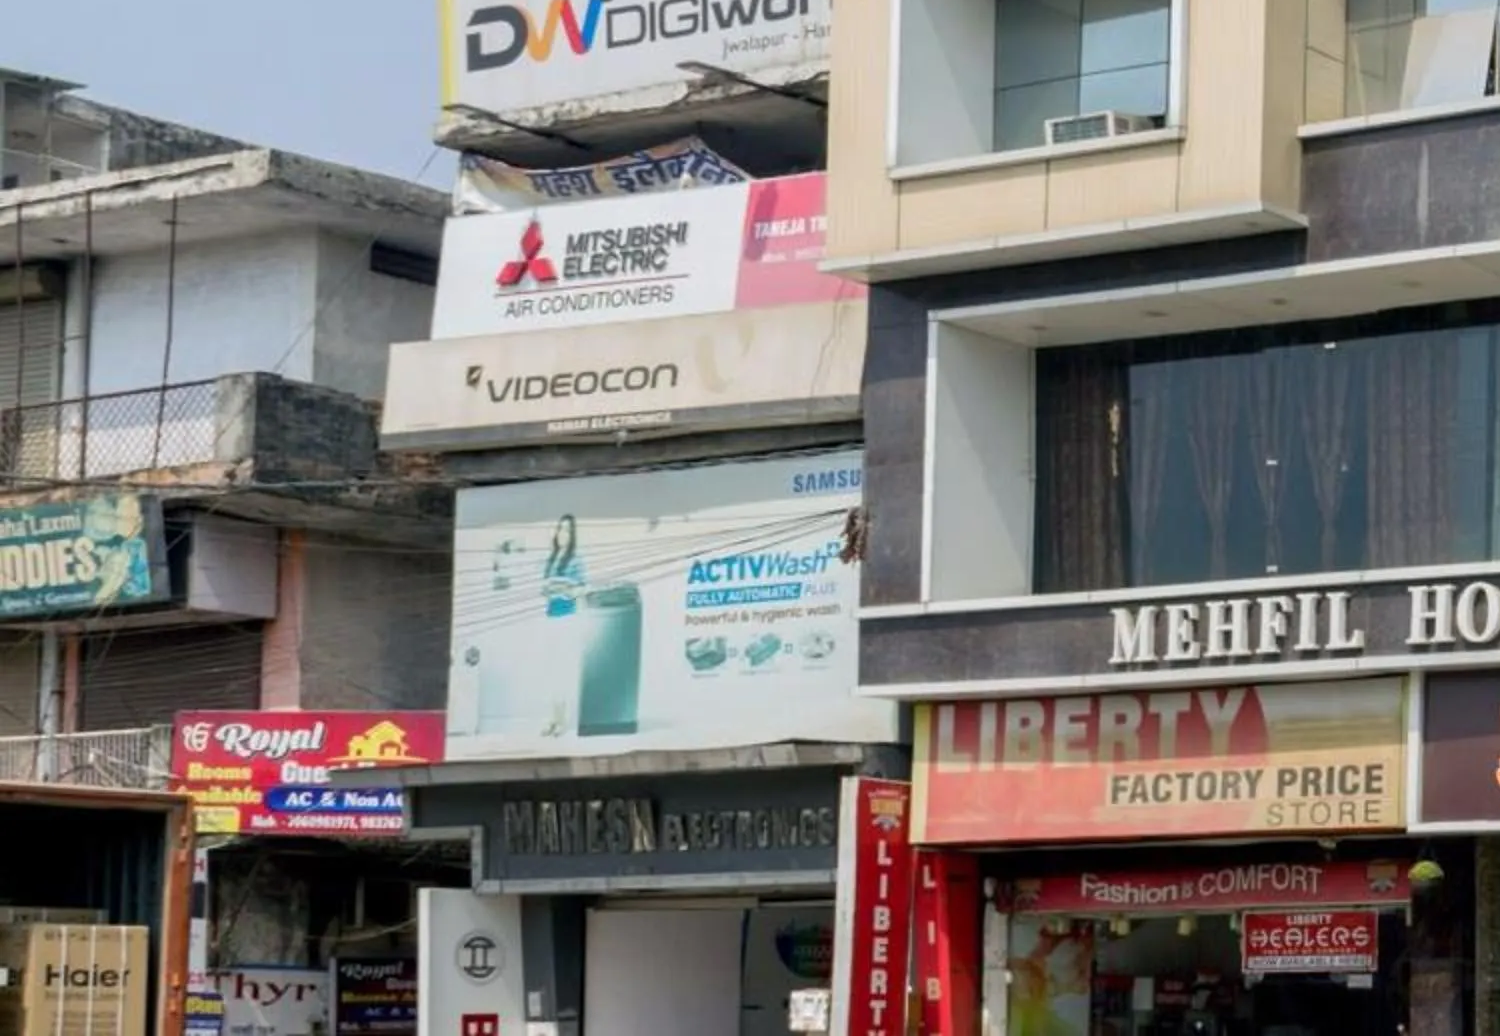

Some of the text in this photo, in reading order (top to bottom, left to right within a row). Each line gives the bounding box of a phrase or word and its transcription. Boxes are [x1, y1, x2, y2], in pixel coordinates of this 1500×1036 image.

[566, 221, 689, 255] MITSUBISHI
[563, 247, 670, 279] ELECTRIC
[504, 284, 675, 318] AIR CONDITIONERS
[688, 591, 724, 608] FULLY
[727, 584, 799, 602] AUTOMATIC
[1109, 590, 1366, 665] MEHFIL
[214, 720, 327, 758] Royal
[936, 687, 1253, 775] LIBERTY
[284, 792, 313, 807] AC
[343, 792, 380, 808] Non
[1110, 764, 1385, 805] FACTORY PRICE
[1265, 800, 1383, 828] STORE
[1080, 872, 1178, 905] Fashion
[1198, 863, 1323, 897] COMFORT
[923, 865, 943, 1036] LIB
[45, 963, 131, 987] Haier
